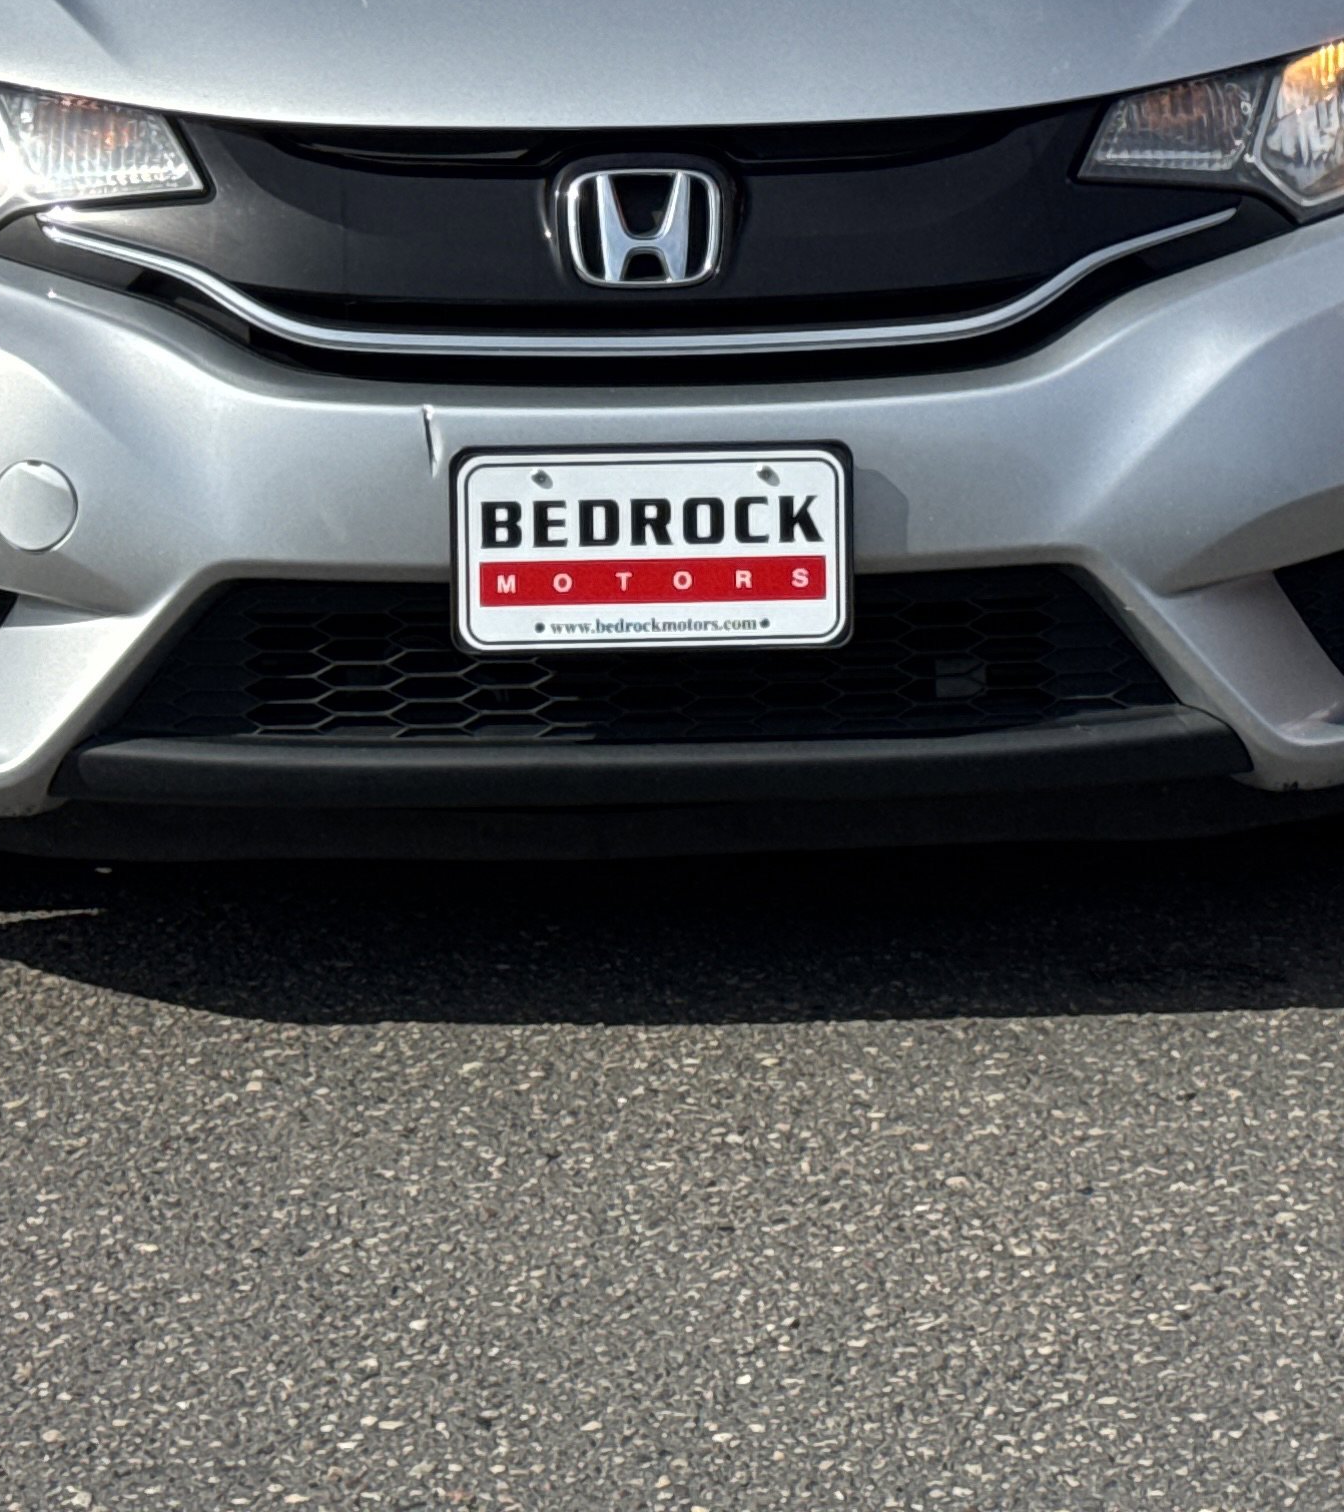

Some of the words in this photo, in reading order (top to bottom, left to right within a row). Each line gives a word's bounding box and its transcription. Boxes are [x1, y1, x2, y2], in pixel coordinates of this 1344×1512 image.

[480, 495, 825, 549] BEDROCK
[496, 567, 810, 595] MOTORS
[550, 615, 758, 635] www.bedrockmotors.com
